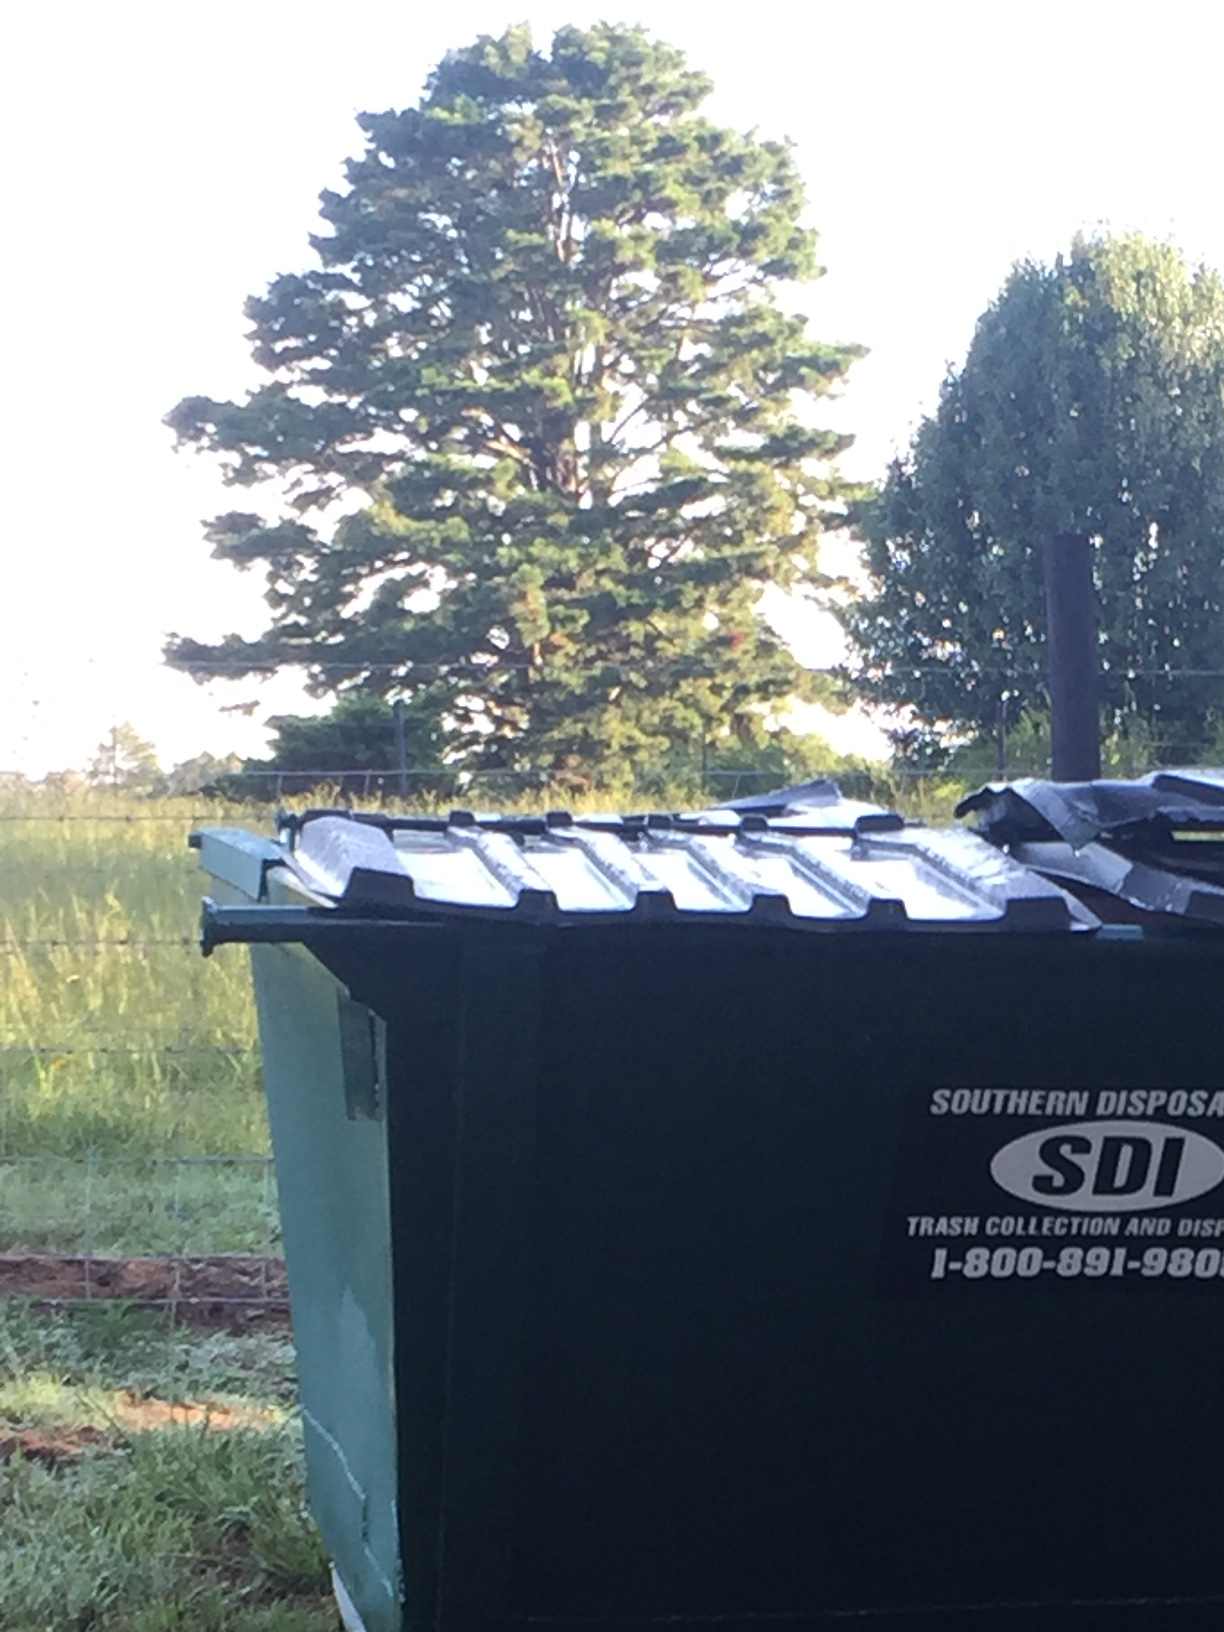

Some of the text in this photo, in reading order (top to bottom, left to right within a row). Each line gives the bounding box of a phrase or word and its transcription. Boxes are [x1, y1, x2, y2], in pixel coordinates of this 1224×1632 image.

[930, 1088, 1089, 1116] SOUTHERN
[1031, 1135, 1186, 1197] SDI
[907, 1216, 979, 1236] TRASH
[985, 1216, 1120, 1237] COLLECTION
[1124, 1217, 1171, 1237] AND
